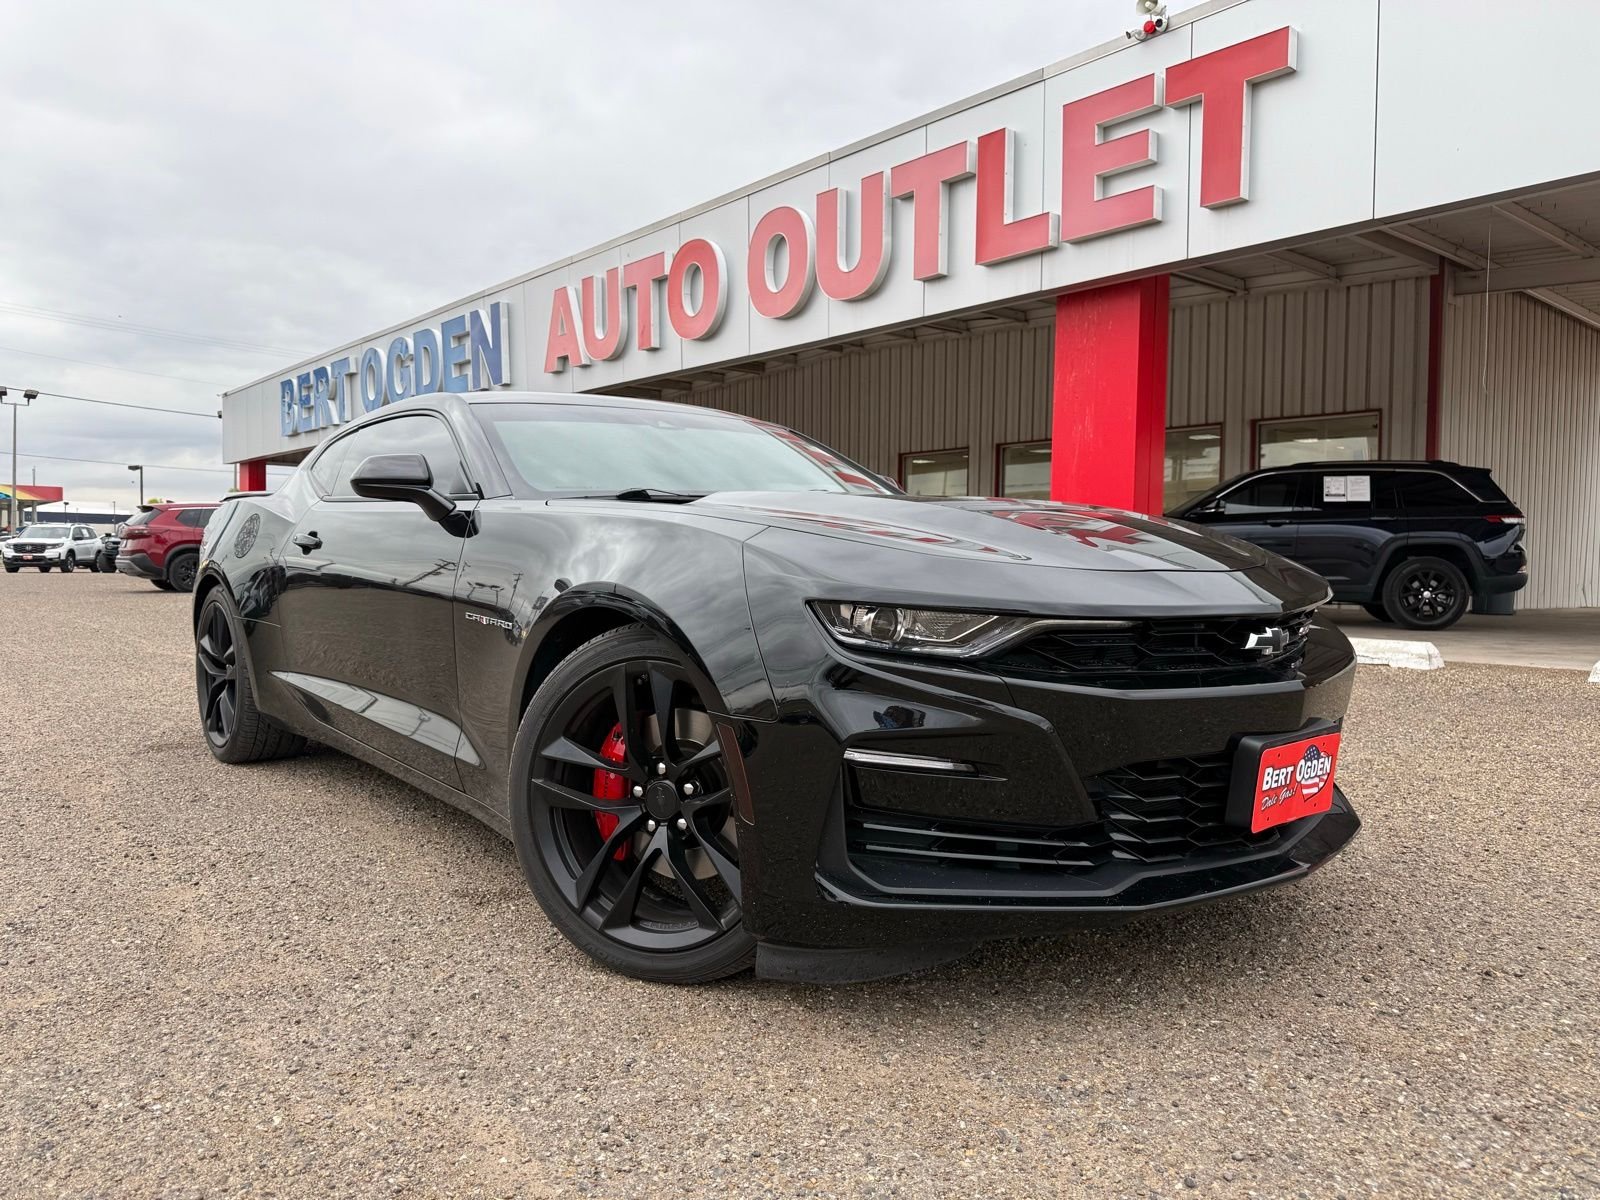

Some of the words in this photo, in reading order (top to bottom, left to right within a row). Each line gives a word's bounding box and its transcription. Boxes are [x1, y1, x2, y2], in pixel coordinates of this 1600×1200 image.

[280, 357, 357, 437] BERT
[360, 301, 511, 414] OGDEN
[544, 237, 728, 374] AUTO
[747, 25, 1298, 319] OUTLET
[1262, 766, 1295, 791] BERT
[1296, 756, 1332, 782] OGDEN
